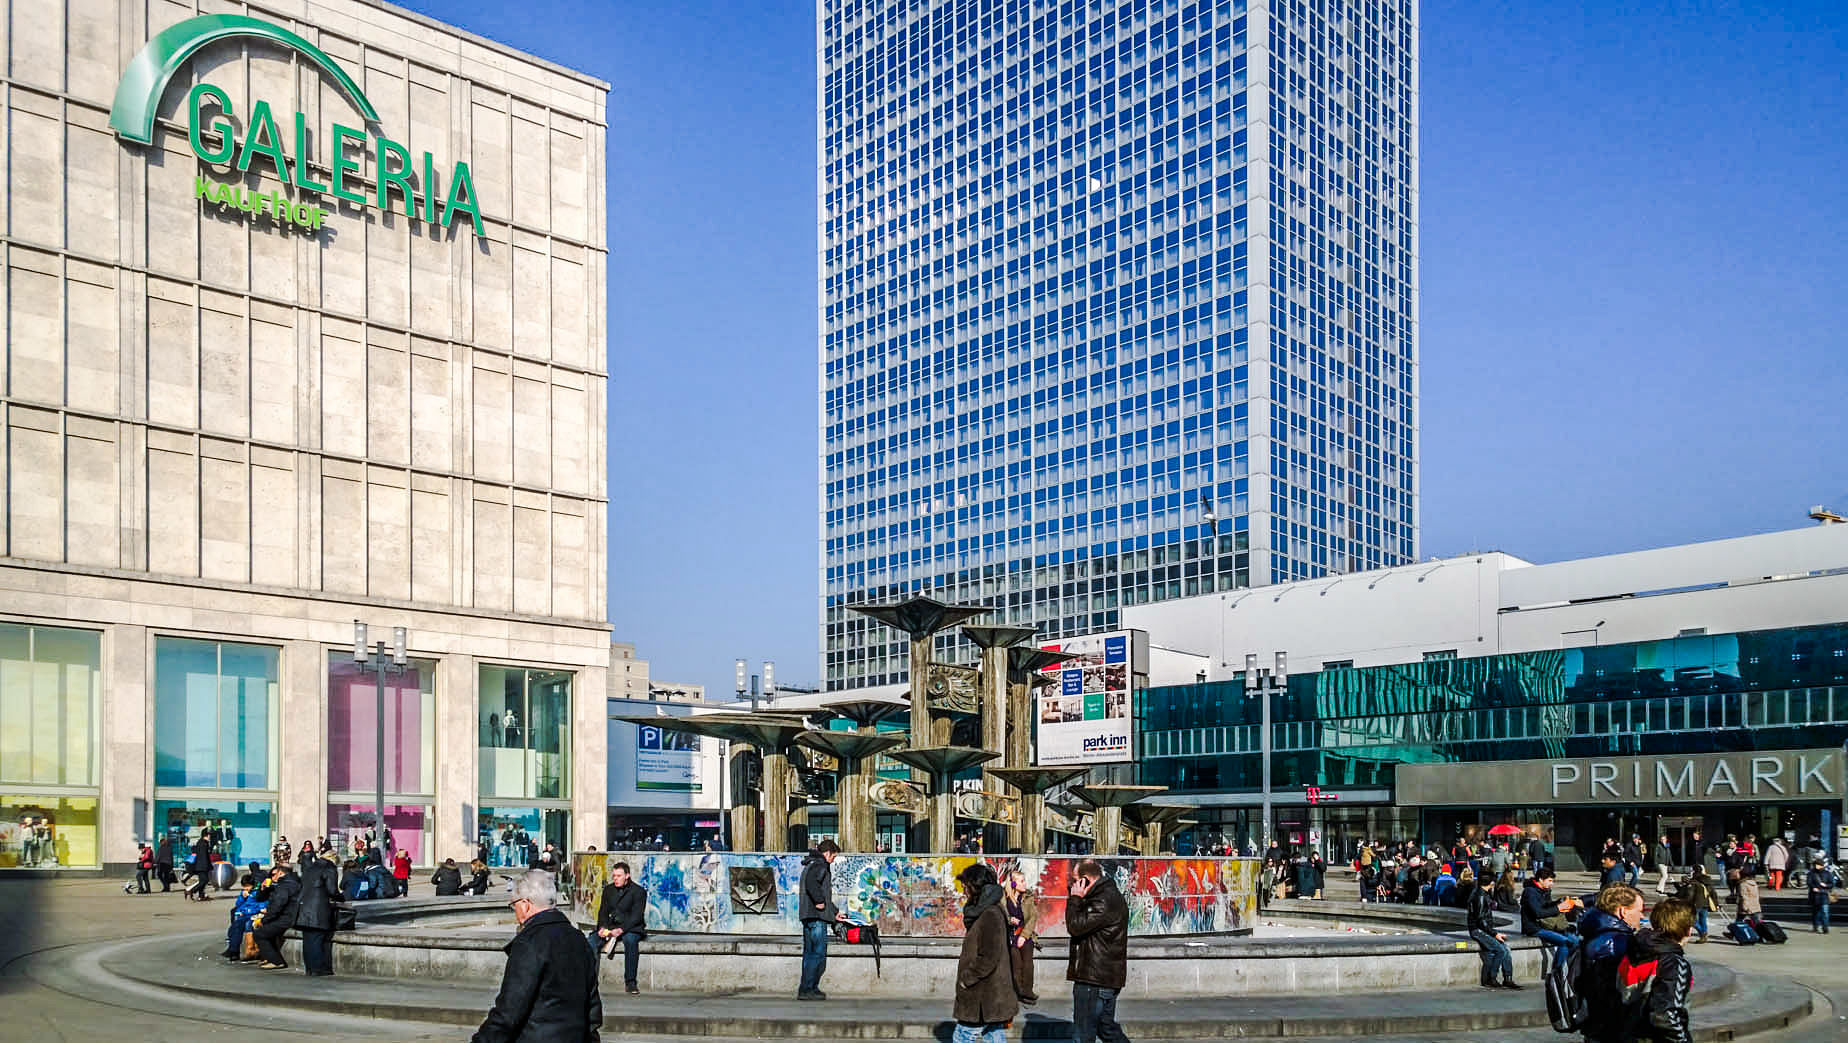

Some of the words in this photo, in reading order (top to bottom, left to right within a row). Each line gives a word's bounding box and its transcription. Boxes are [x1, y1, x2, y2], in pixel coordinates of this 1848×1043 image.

[187, 83, 486, 239] GALERIA
[644, 730, 656, 747] P
[1083, 735, 1107, 752] park
[1110, 734, 1127, 746] inn
[1551, 753, 1834, 799] PRIMARK
